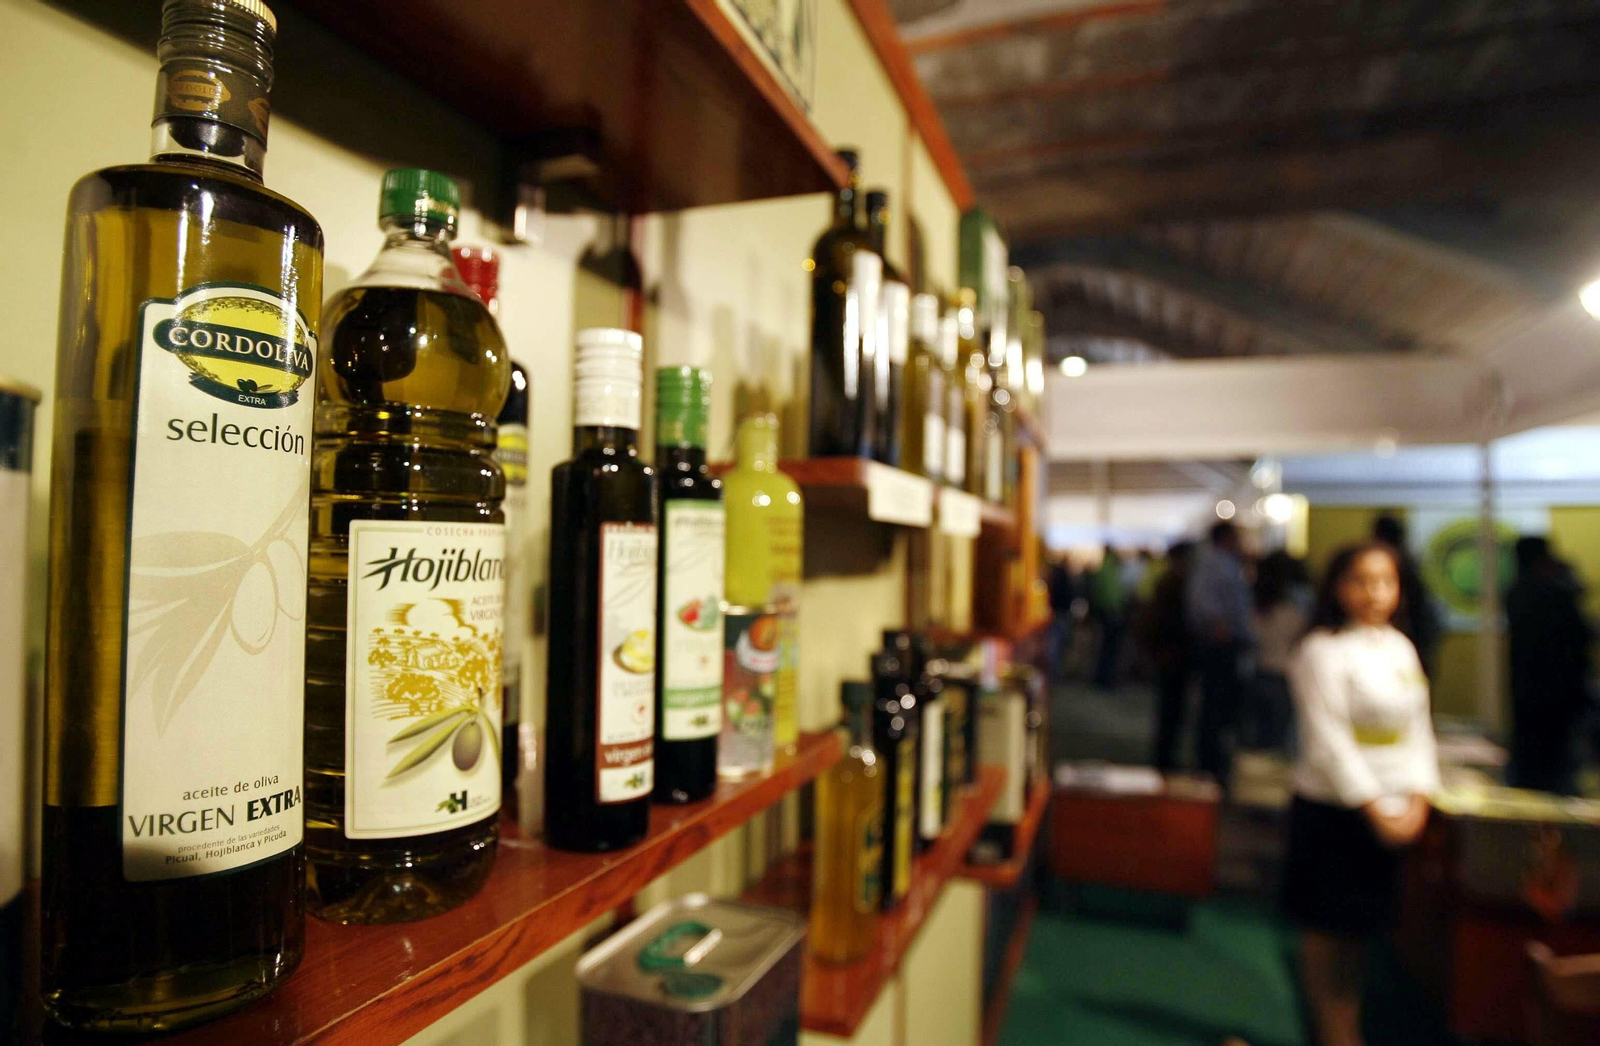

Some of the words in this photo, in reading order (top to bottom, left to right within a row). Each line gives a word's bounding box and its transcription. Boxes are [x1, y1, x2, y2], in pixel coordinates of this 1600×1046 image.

[168, 326, 310, 372] CORDOLIVA
[238, 394, 267, 406] EXTRA
[166, 412, 304, 456] selección
[426, 525, 475, 537] COSECHA
[182, 786, 228, 801] aceite
[233, 781, 250, 794] de
[253, 774, 280, 790] oliva
[127, 804, 236, 838] VIRGEN
[246, 785, 302, 823] EXTRA
[165, 851, 202, 865] Picual,
[205, 841, 256, 859] Hojiblanca
[257, 836, 263, 849] y
[263, 829, 288, 845] Picuda
[177, 838, 225, 854] procedente
[226, 836, 237, 845] de
[238, 833, 249, 844] las
[249, 824, 281, 839] variedades
